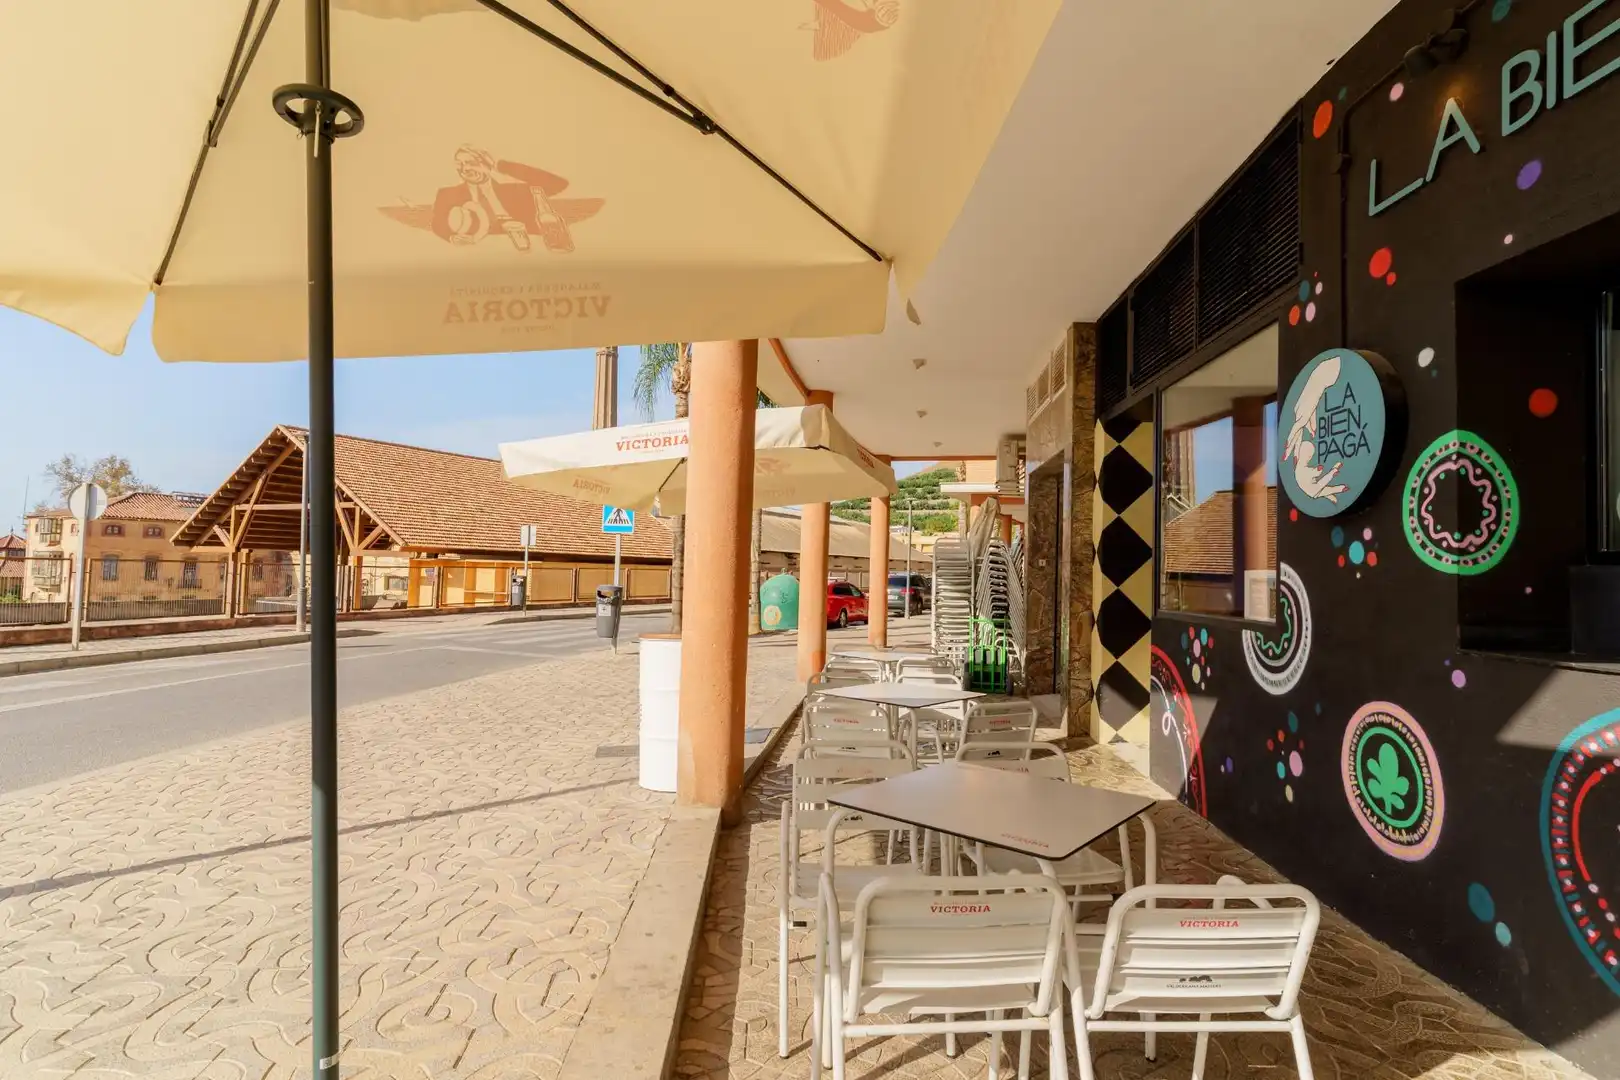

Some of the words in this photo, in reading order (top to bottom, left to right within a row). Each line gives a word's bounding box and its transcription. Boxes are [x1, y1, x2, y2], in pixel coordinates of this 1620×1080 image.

[1368, 97, 1481, 217] LA
[1501, 0, 1620, 137] BIE
[1324, 382, 1356, 412] LA
[1318, 405, 1361, 439] BIEN
[616, 434, 689, 452] VICTORIA
[1317, 423, 1371, 464] PAGÁ
[930, 904, 991, 913] VICTORIA
[1179, 919, 1240, 928] VICTORIA
